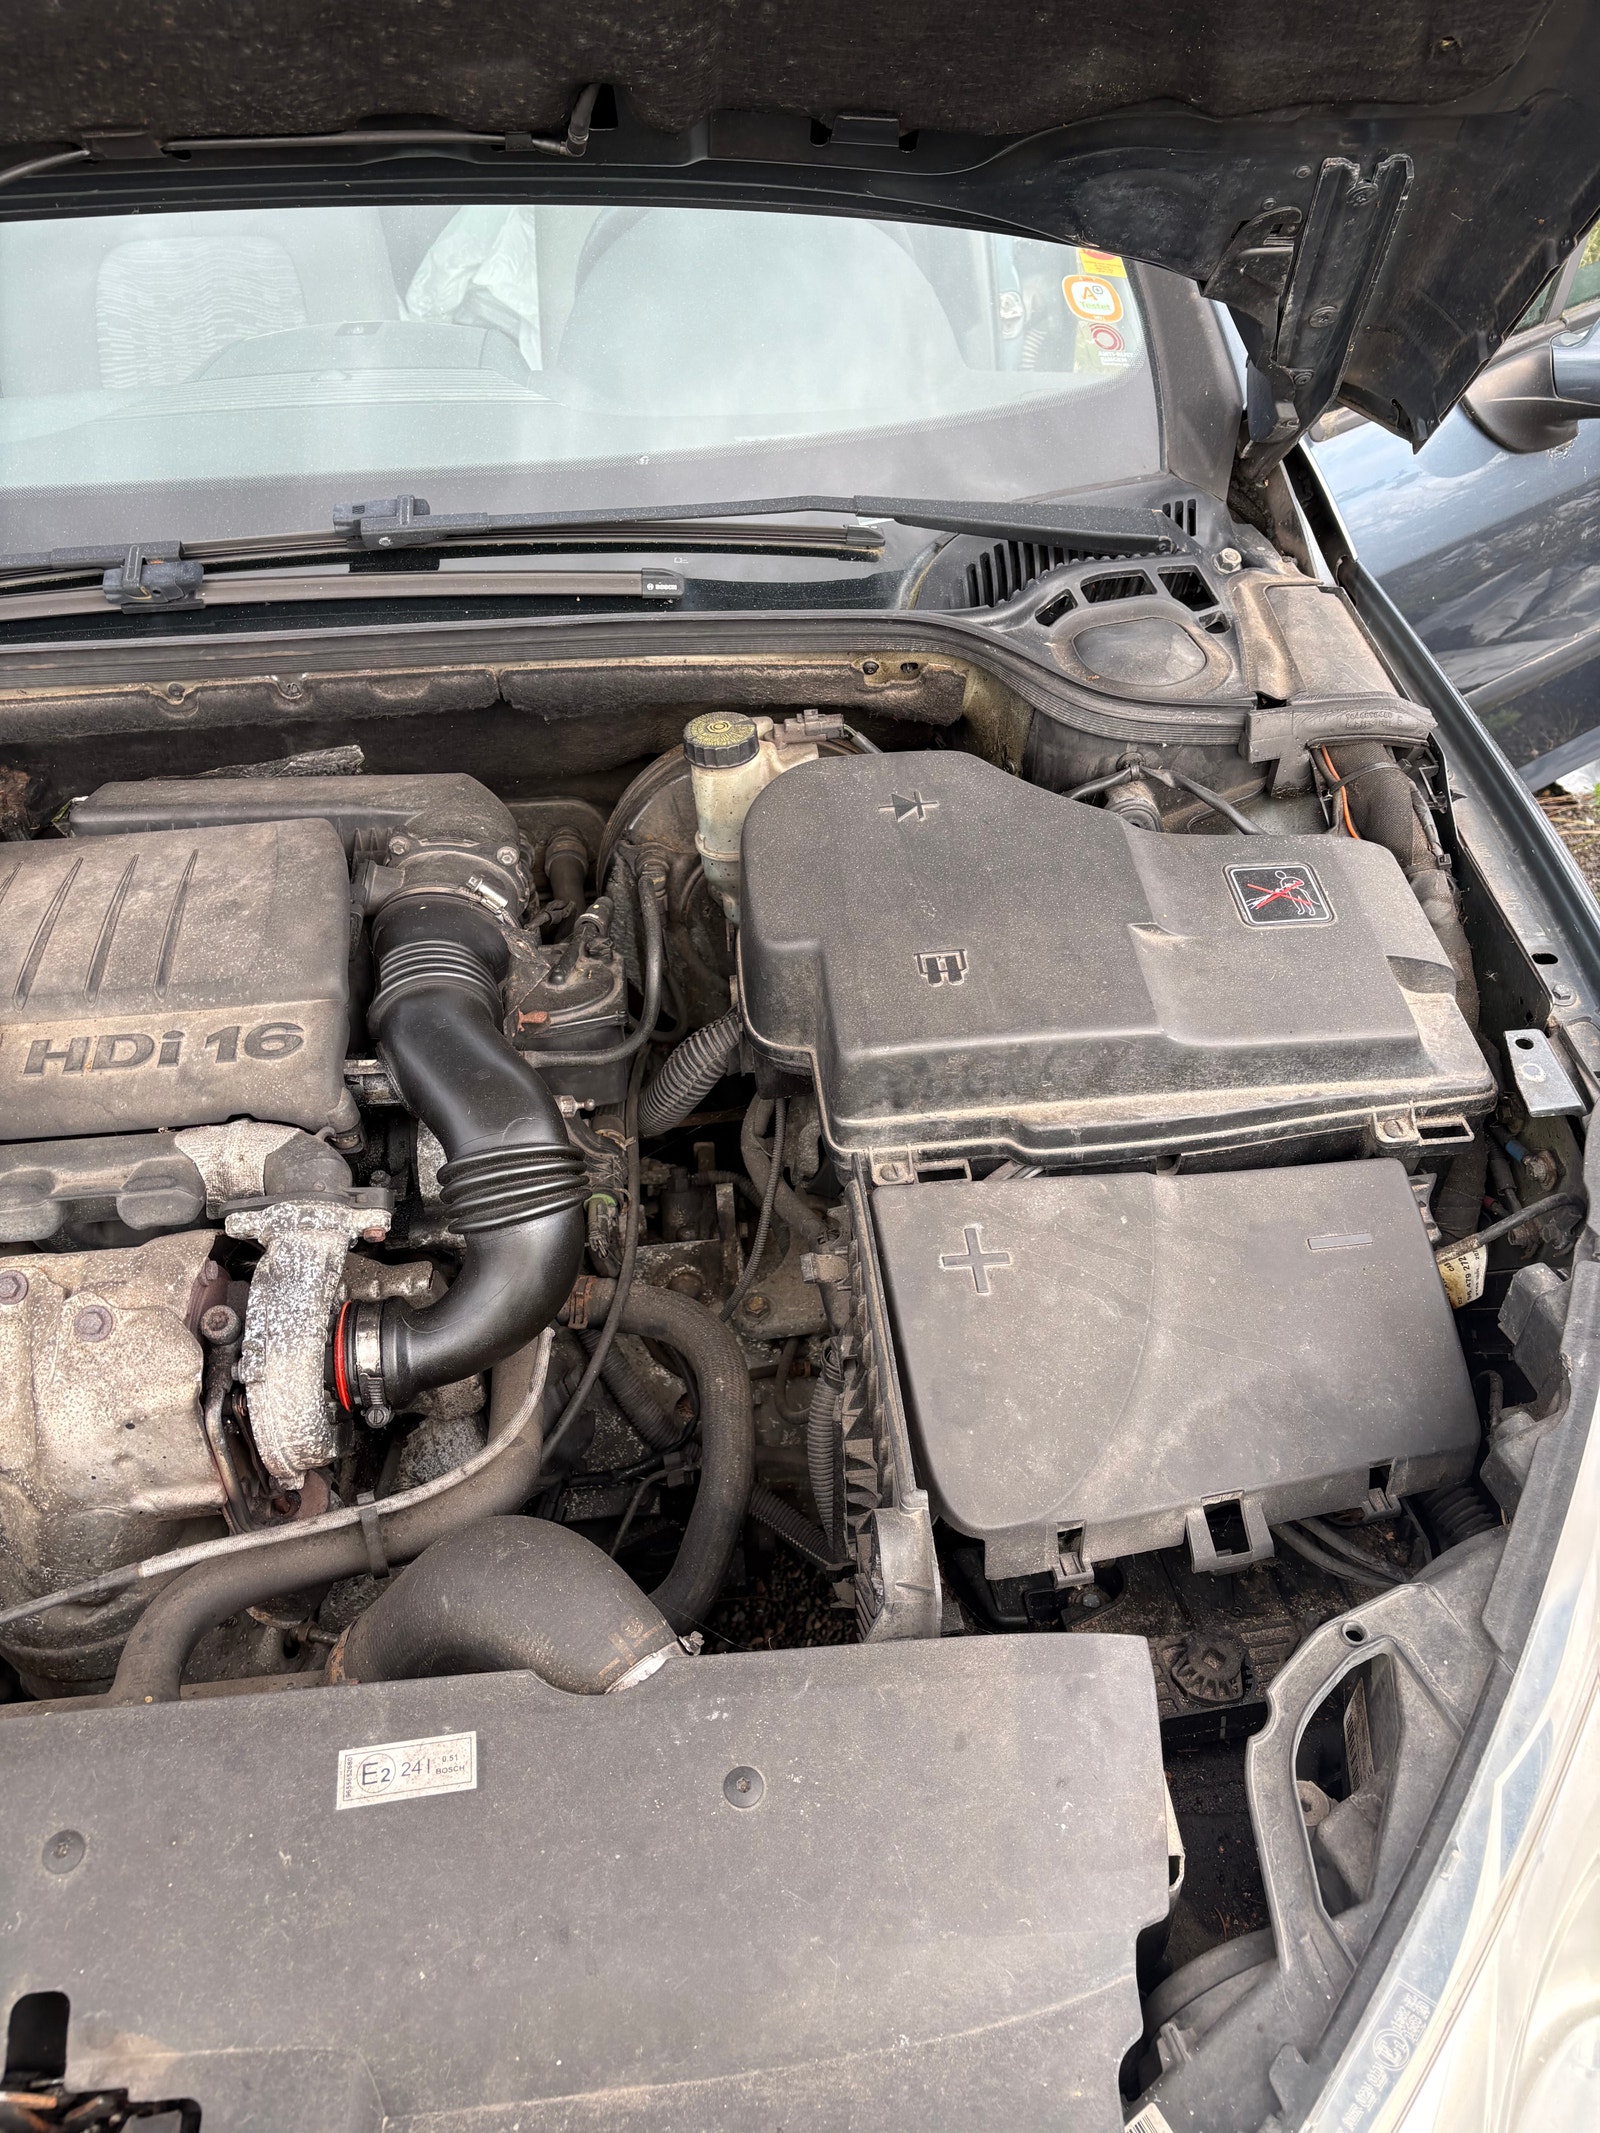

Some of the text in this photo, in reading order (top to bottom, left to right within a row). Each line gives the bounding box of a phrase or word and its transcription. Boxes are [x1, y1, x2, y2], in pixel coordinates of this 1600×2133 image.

[23, 1022, 304, 1075] HDi 16
[1458, 1256, 1471, 1271] 272
[361, 1761, 391, 1786] E2
[435, 1765, 465, 1775] BOSCH
